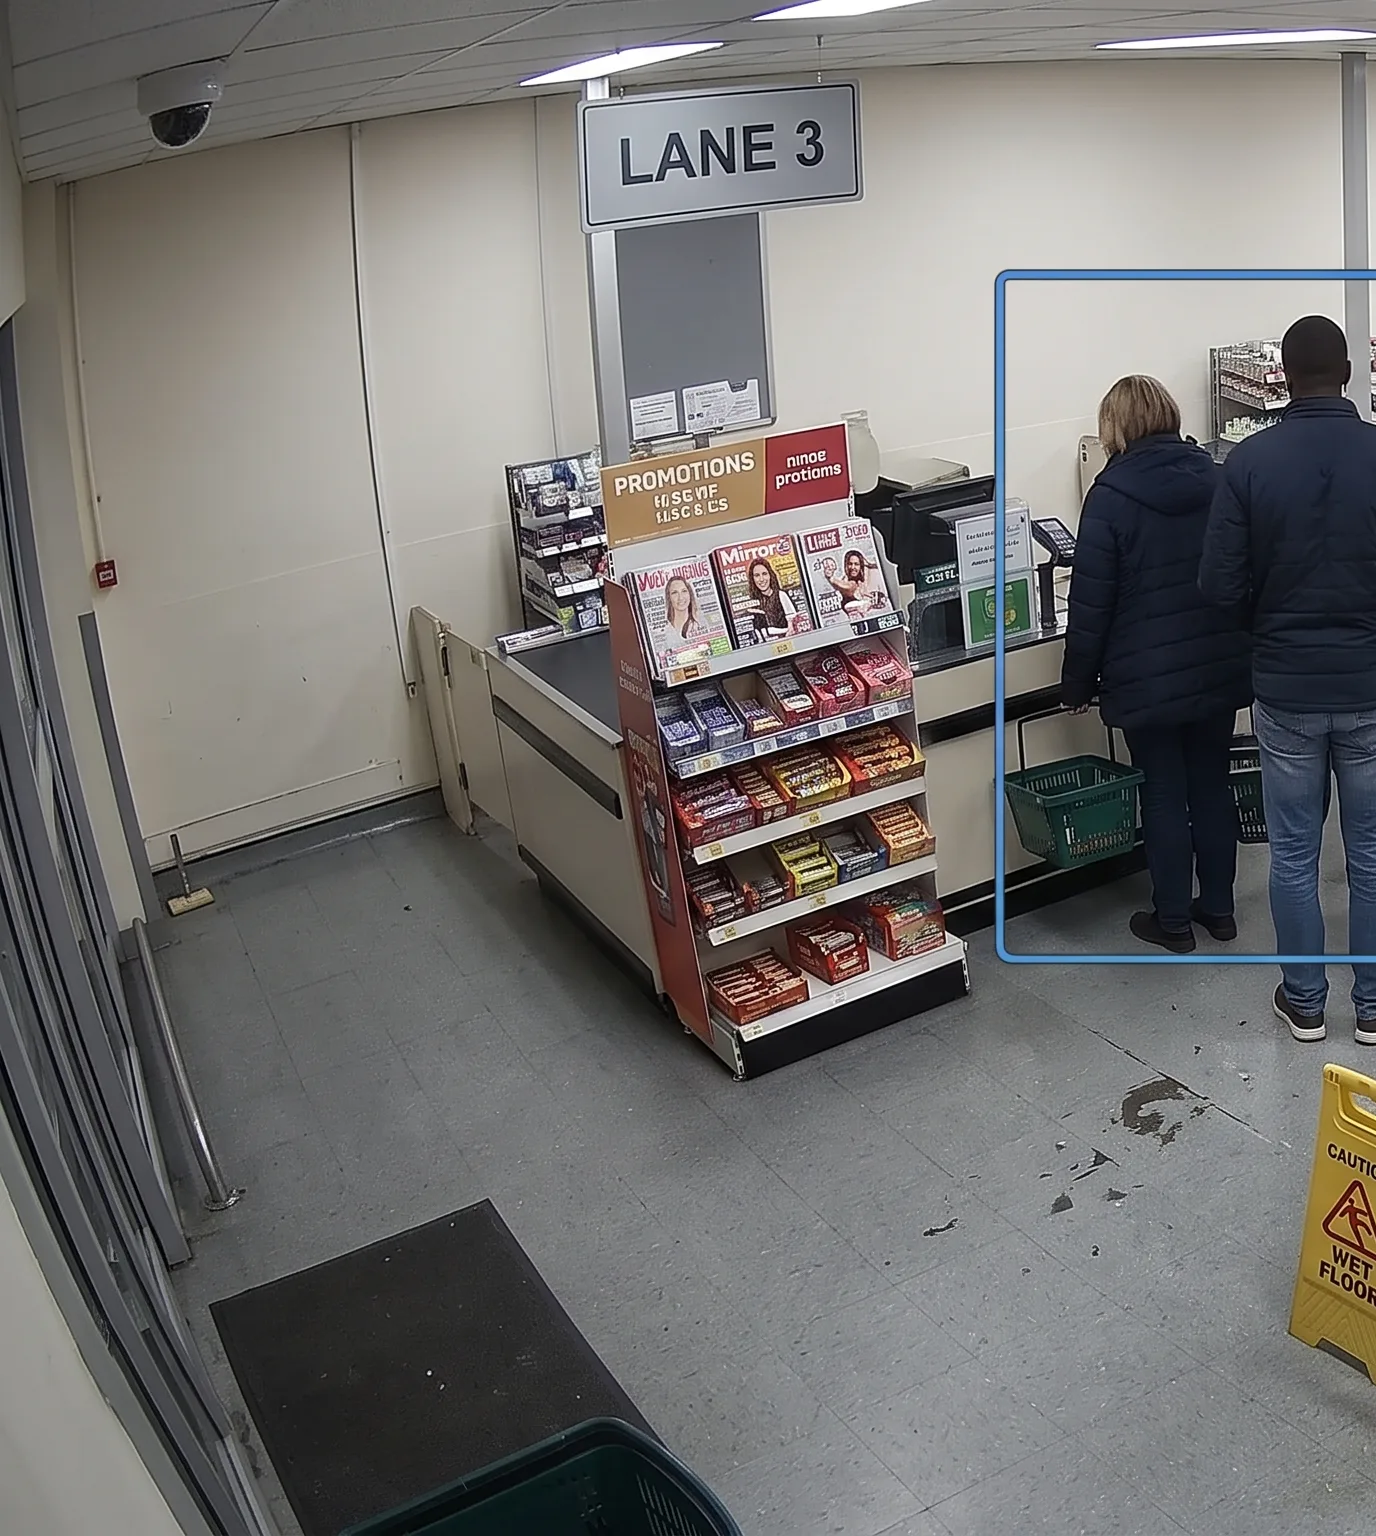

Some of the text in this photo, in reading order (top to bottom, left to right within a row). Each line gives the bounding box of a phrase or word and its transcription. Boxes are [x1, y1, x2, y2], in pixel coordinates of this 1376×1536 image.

[621, 120, 824, 186] LANE 3
[614, 451, 755, 496] PROMOTIONS
[721, 543, 777, 567] Mirror
[1332, 1244, 1373, 1280] WET
